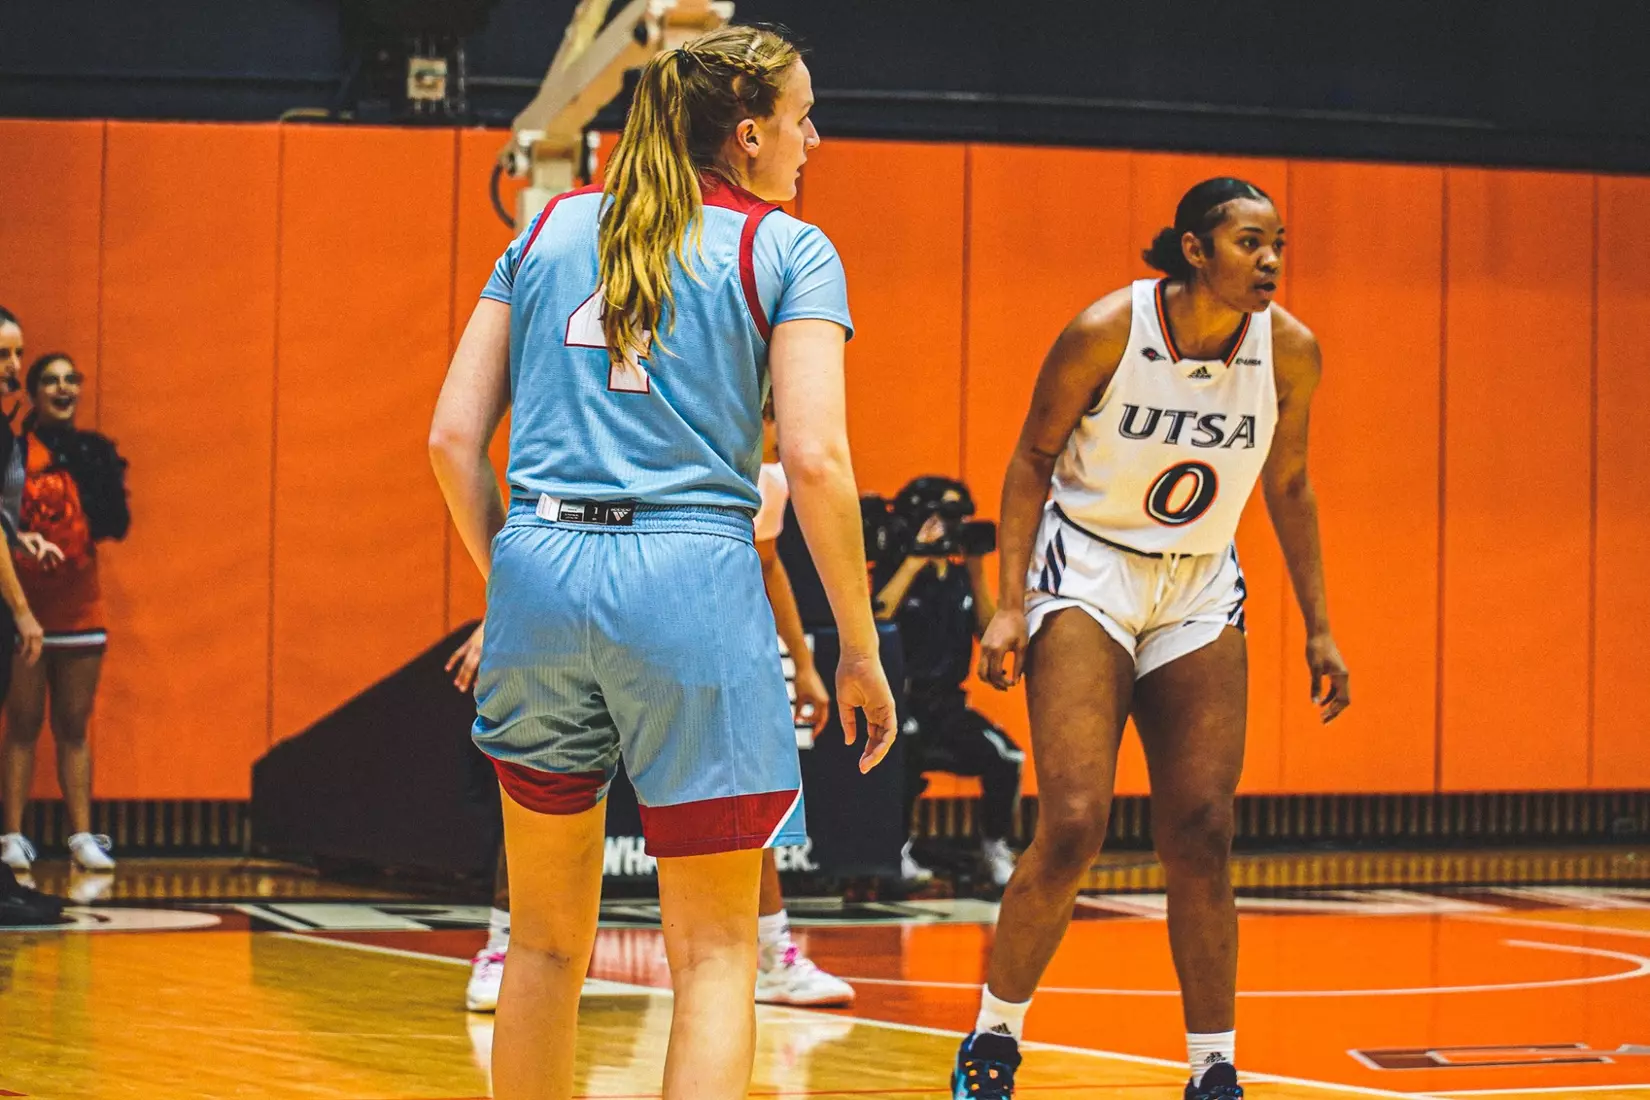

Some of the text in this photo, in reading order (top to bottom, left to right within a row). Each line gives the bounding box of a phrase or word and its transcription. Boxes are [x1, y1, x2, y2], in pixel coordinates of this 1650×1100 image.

[564, 281, 653, 394] 4
[1117, 404, 1256, 449] UTSA
[1142, 459, 1219, 528] 0
